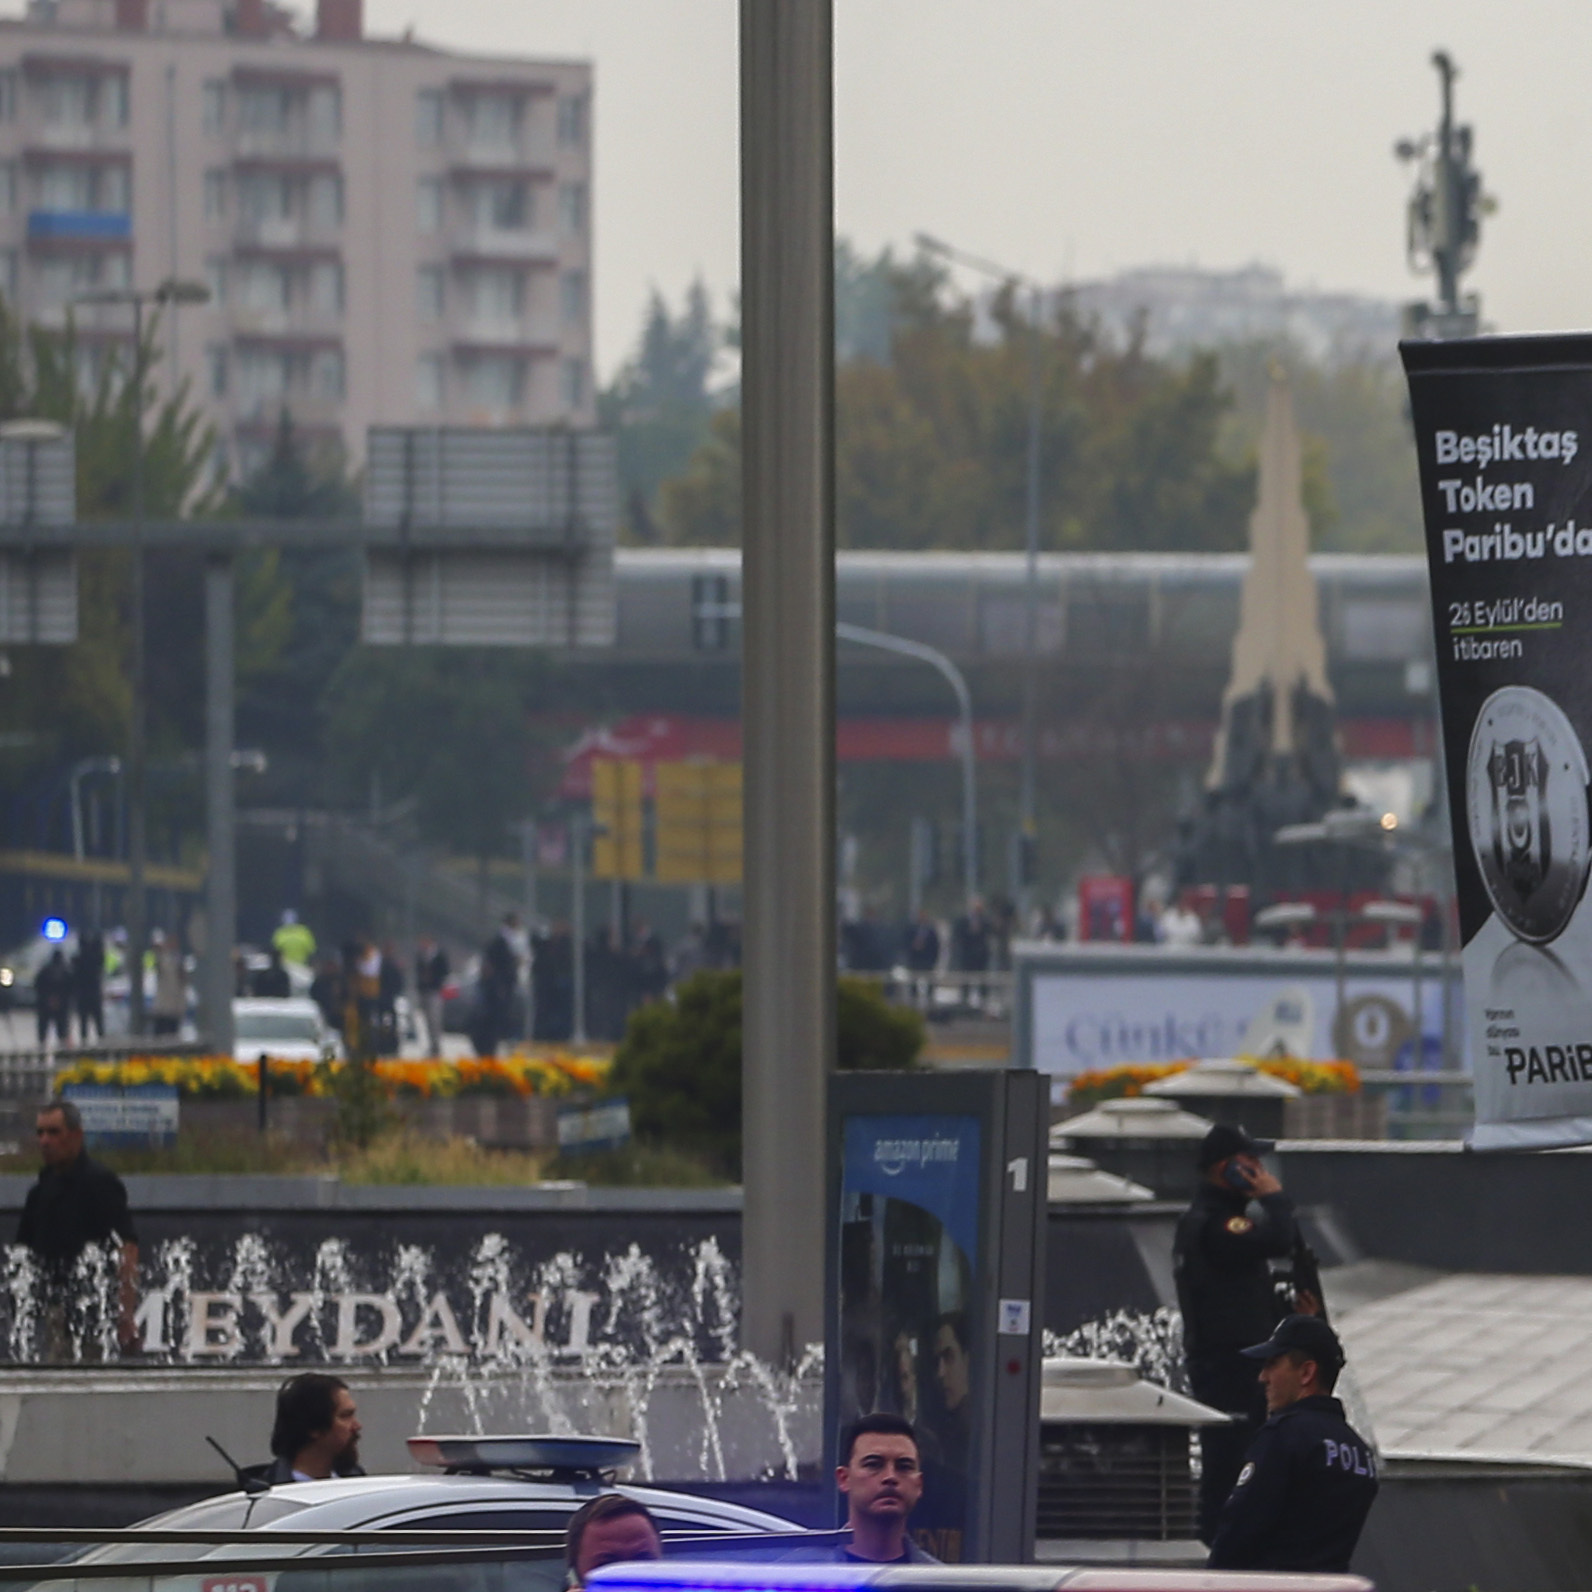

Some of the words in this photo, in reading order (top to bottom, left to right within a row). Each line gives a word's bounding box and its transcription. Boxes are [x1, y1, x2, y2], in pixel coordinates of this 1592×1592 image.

[1435, 424, 1578, 467] Beşiktaş
[1439, 476, 1534, 513] Token
[1474, 597, 1563, 629] Eylül'den
[1453, 636, 1522, 661] itibaren
[1007, 1157, 1028, 1192] 1
[1323, 1438, 1374, 1478] POLİ
